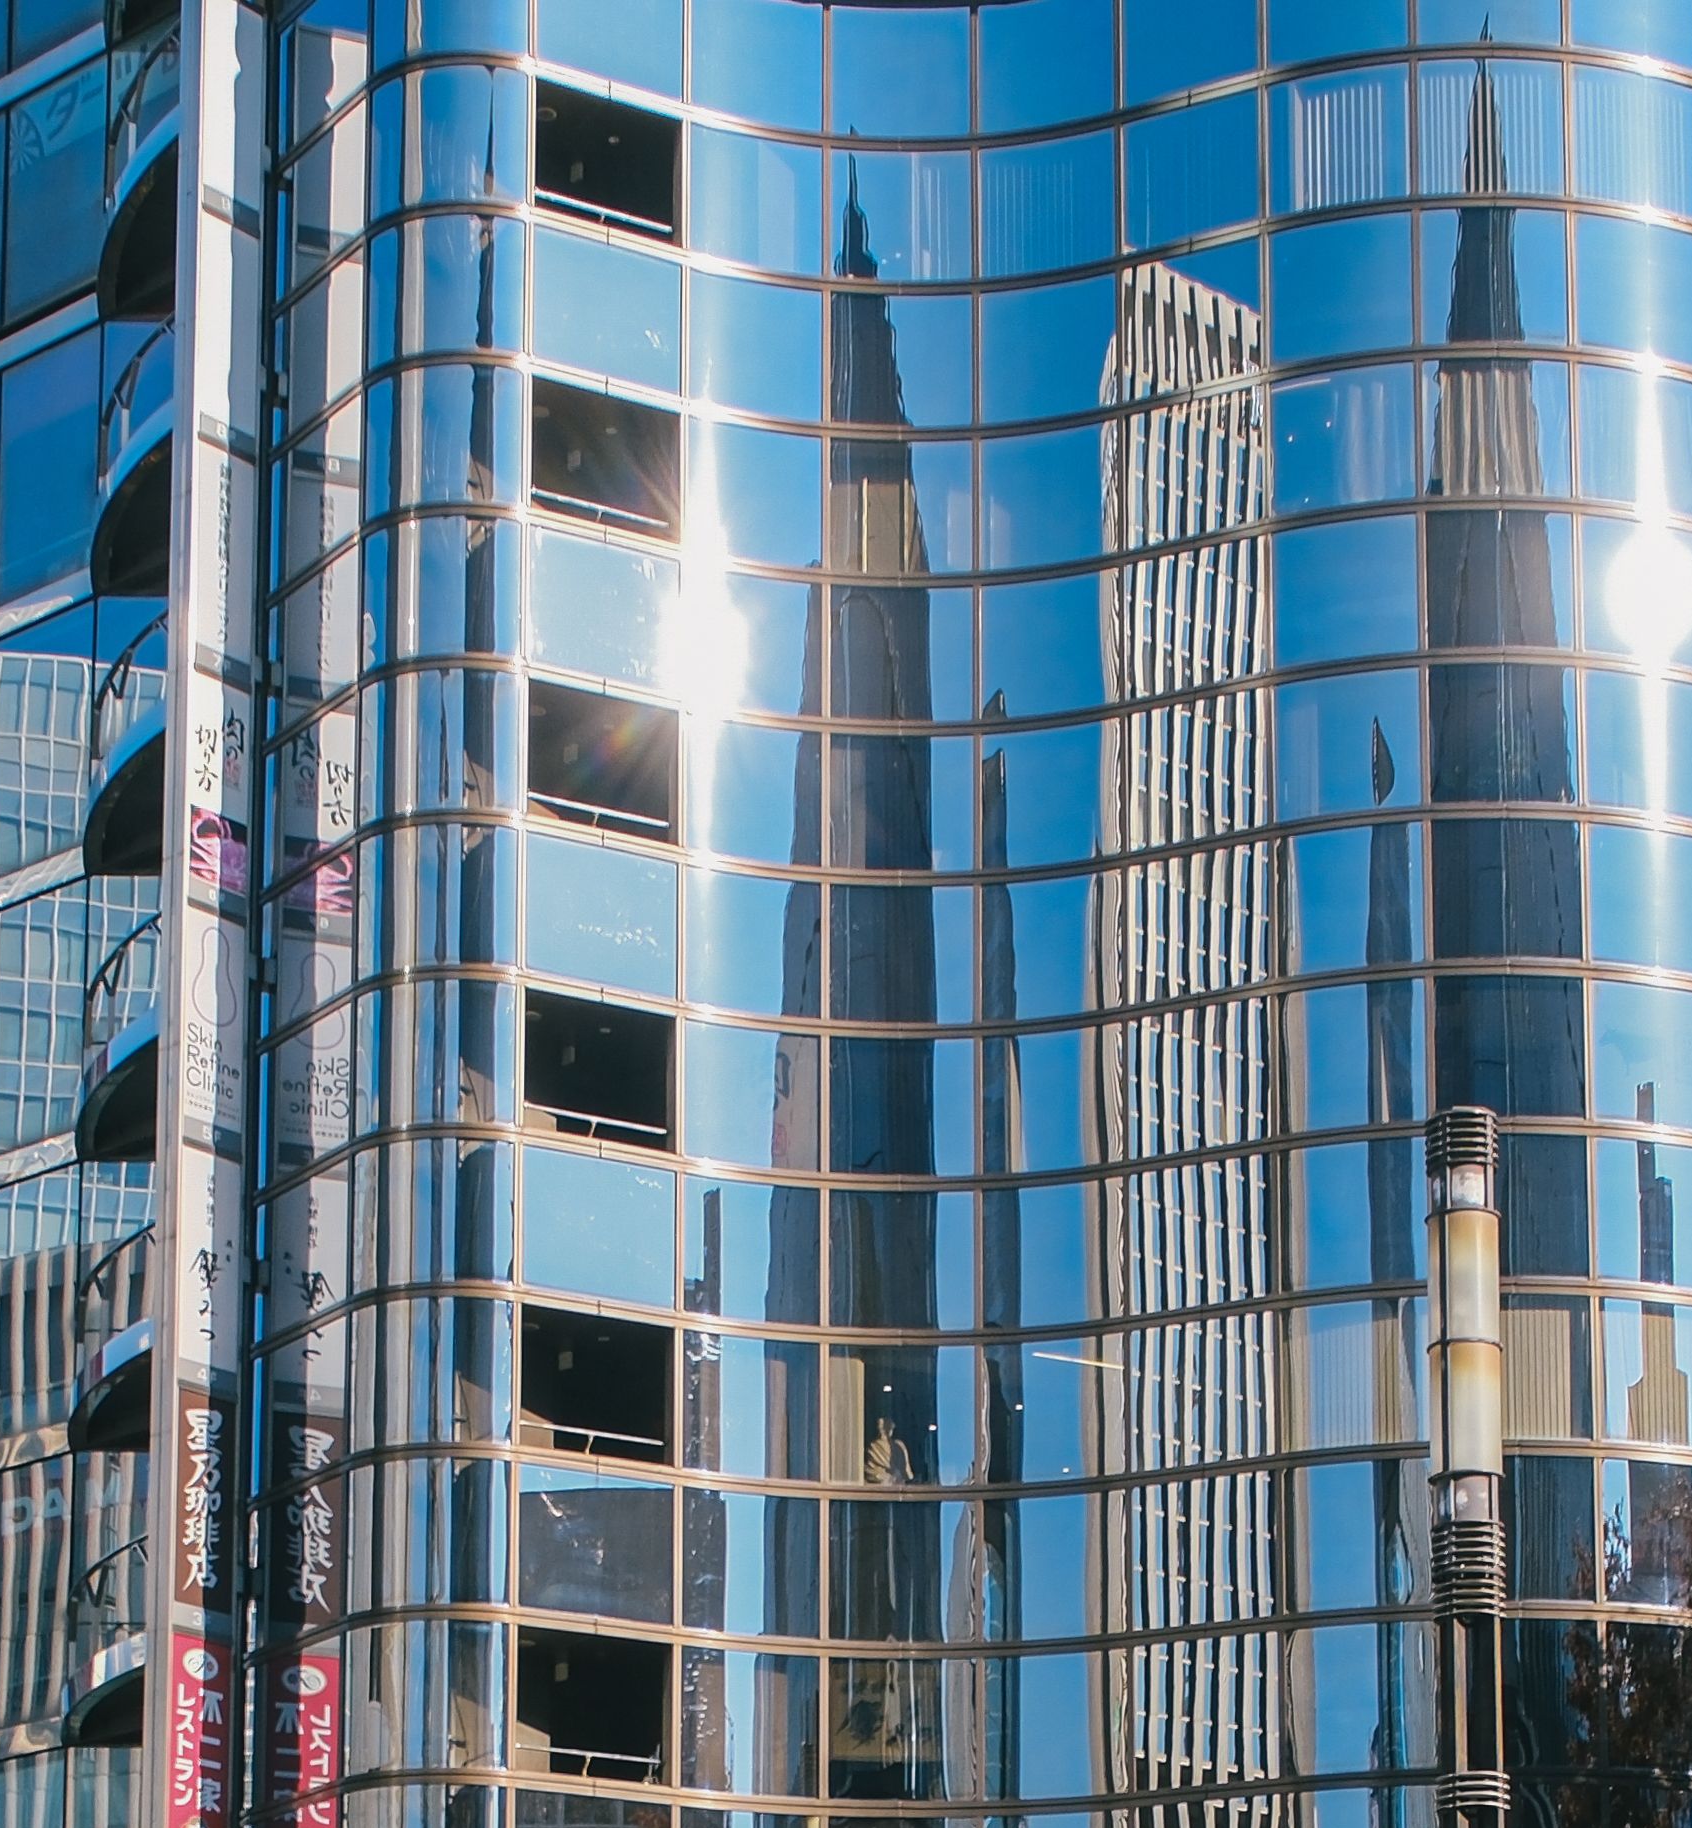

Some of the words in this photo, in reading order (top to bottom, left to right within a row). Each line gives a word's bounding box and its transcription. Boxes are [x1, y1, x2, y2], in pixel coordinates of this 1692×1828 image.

[187, 1022, 223, 1051] Skin
[186, 1045, 240, 1077] Refine
[185, 1067, 233, 1099] Clinic
[173, 1682, 197, 1807] レストラン
[197, 1686, 224, 1814] 不二家
